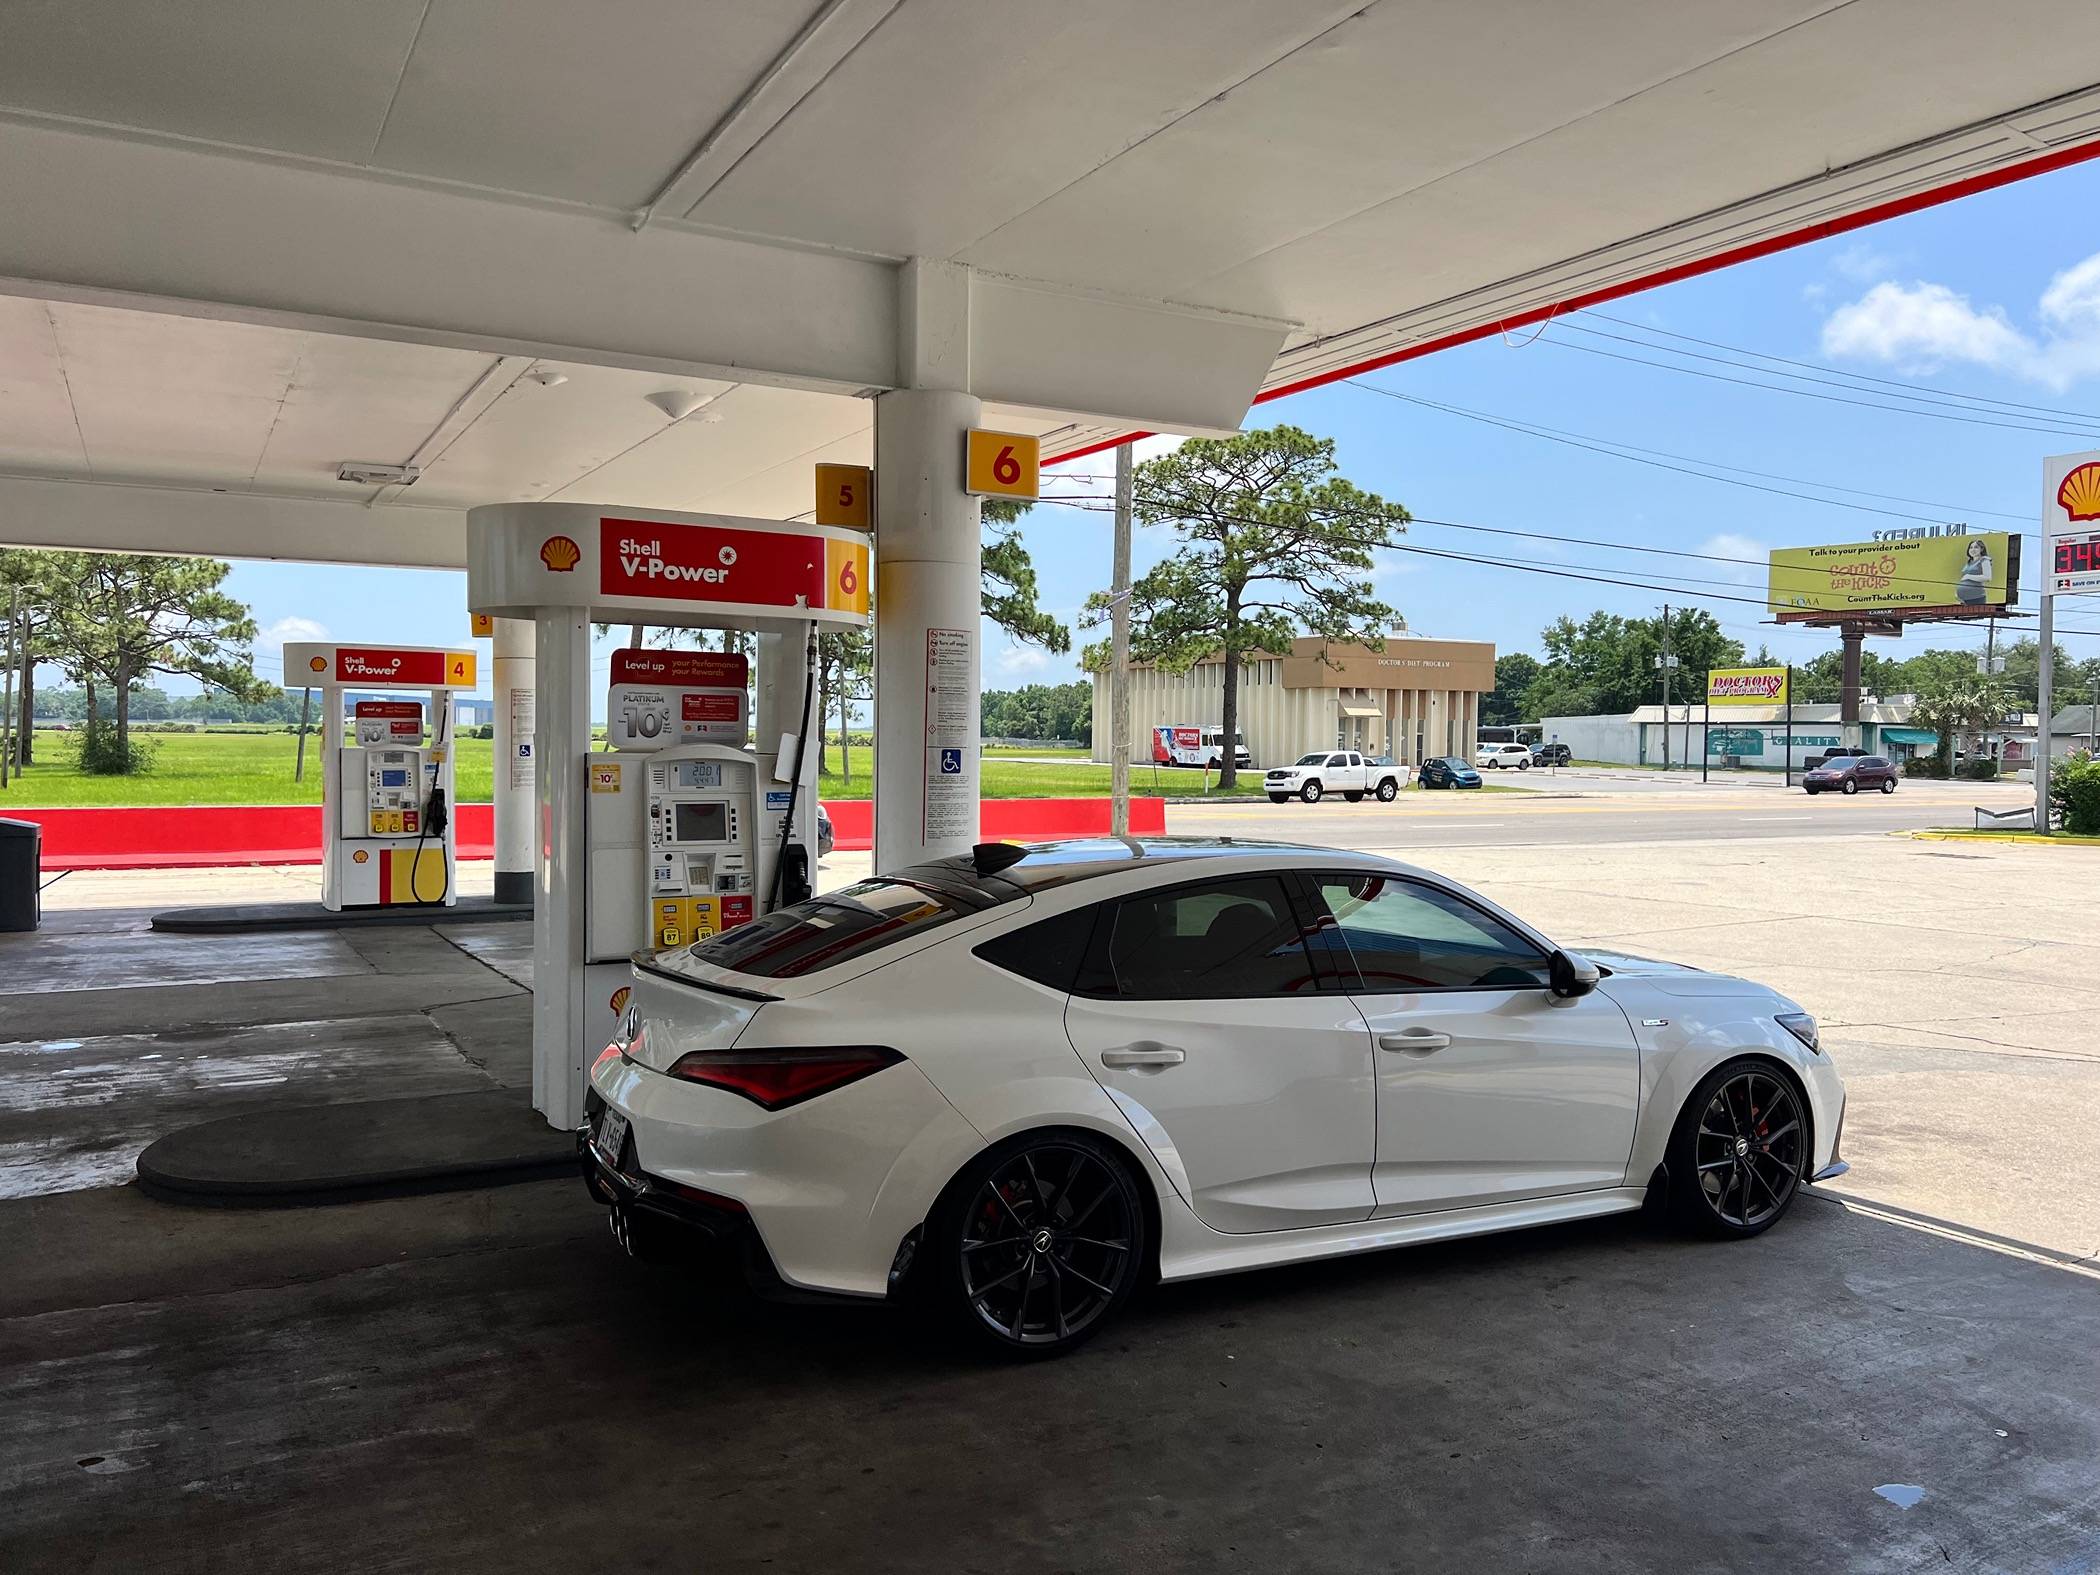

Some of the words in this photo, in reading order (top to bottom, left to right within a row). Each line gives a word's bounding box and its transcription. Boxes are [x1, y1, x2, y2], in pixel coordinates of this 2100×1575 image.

[992, 446, 1021, 485] 6
[838, 485, 854, 507] 5
[619, 538, 661, 556] Shell
[1808, 549, 1827, 557] Talk
[1839, 548, 1857, 557] your
[1858, 544, 1893, 555] provider
[1895, 543, 1920, 551] about
[619, 556, 729, 584] V-Power
[839, 560, 858, 595] 6
[1847, 593, 1925, 603] CountTheKicks.org
[478, 615, 488, 626] 3
[345, 656, 365, 664] Shell
[625, 660, 650, 670] Level
[652, 663, 665, 672] up
[692, 659, 740, 669] Performance
[345, 664, 398, 675] V-Power
[454, 661, 464, 677] 4
[672, 668, 690, 676] your
[692, 667, 725, 677] Rewards
[1713, 675, 1783, 688] DOCTORS
[623, 694, 665, 703] PLATINUM
[666, 933, 677, 941] 87
